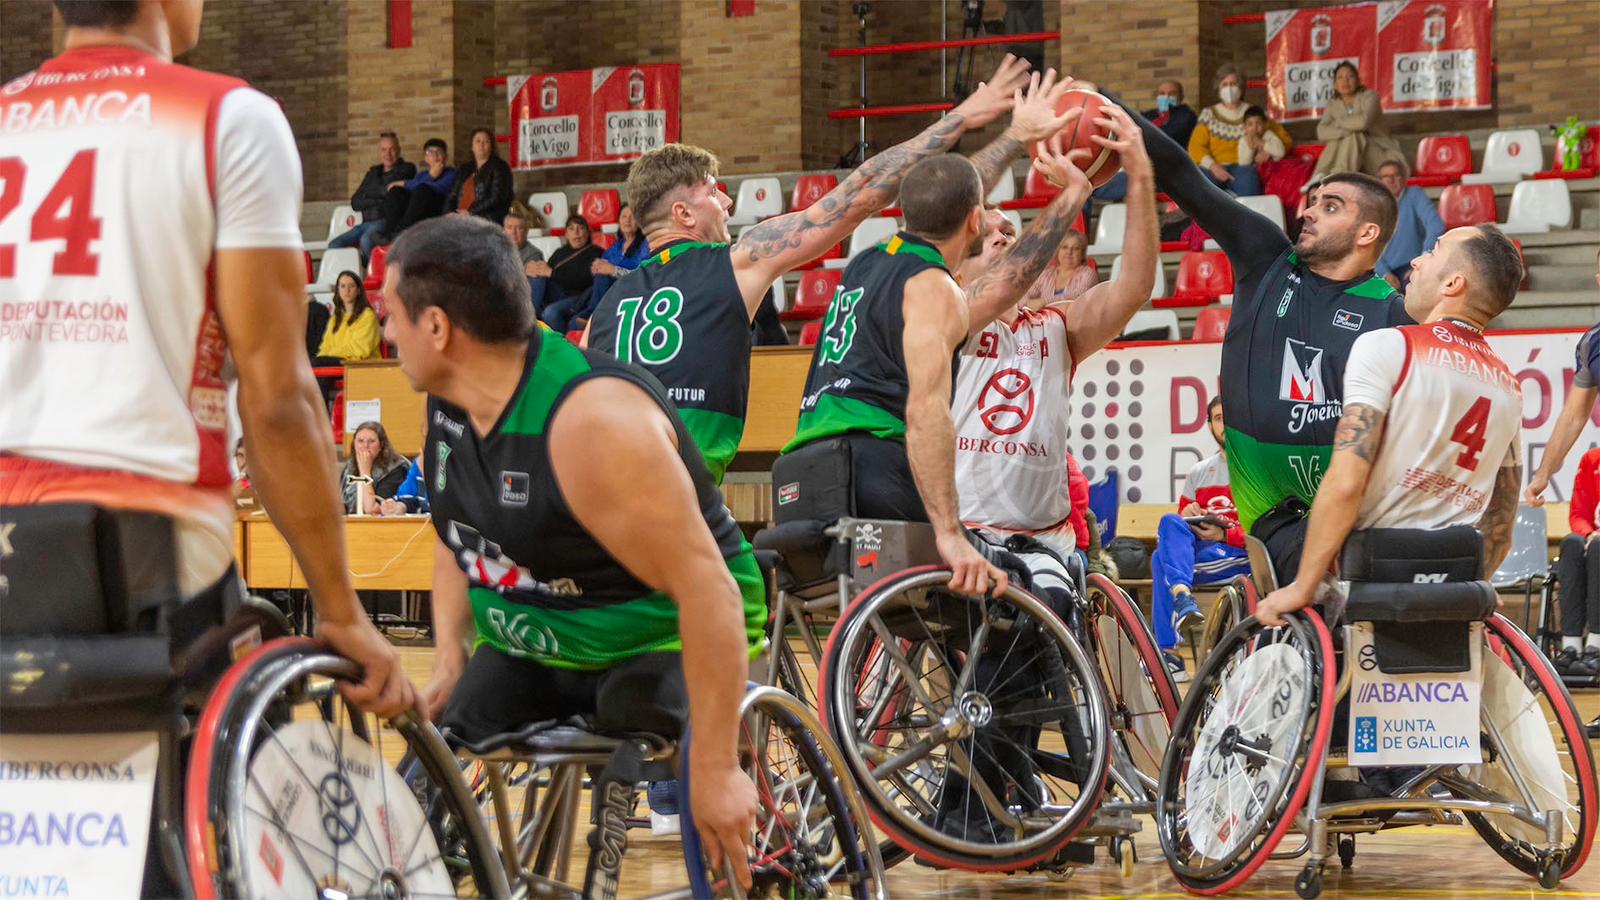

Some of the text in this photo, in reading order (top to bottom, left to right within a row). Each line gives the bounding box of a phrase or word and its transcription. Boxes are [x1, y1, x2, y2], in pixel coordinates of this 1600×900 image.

[1288, 62, 1338, 83] Conce
[1401, 76, 1421, 94] de
[1292, 88, 1309, 104] de
[0, 90, 152, 133] BANCA
[522, 118, 576, 138] Concello
[529, 139, 570, 157] de Vigo
[1, 297, 128, 322] DEPUTACIÓN
[0, 323, 129, 343] PONTEVEDRA
[615, 286, 685, 366] 18
[975, 331, 999, 360] 51
[668, 387, 706, 402] FUTUR
[1450, 395, 1492, 472] 4
[958, 436, 1048, 457] BERCONSA
[1383, 720, 1436, 733] XUNTA
[1383, 736, 1470, 749] DE GALICIA
[0, 876, 70, 898] UNTA
